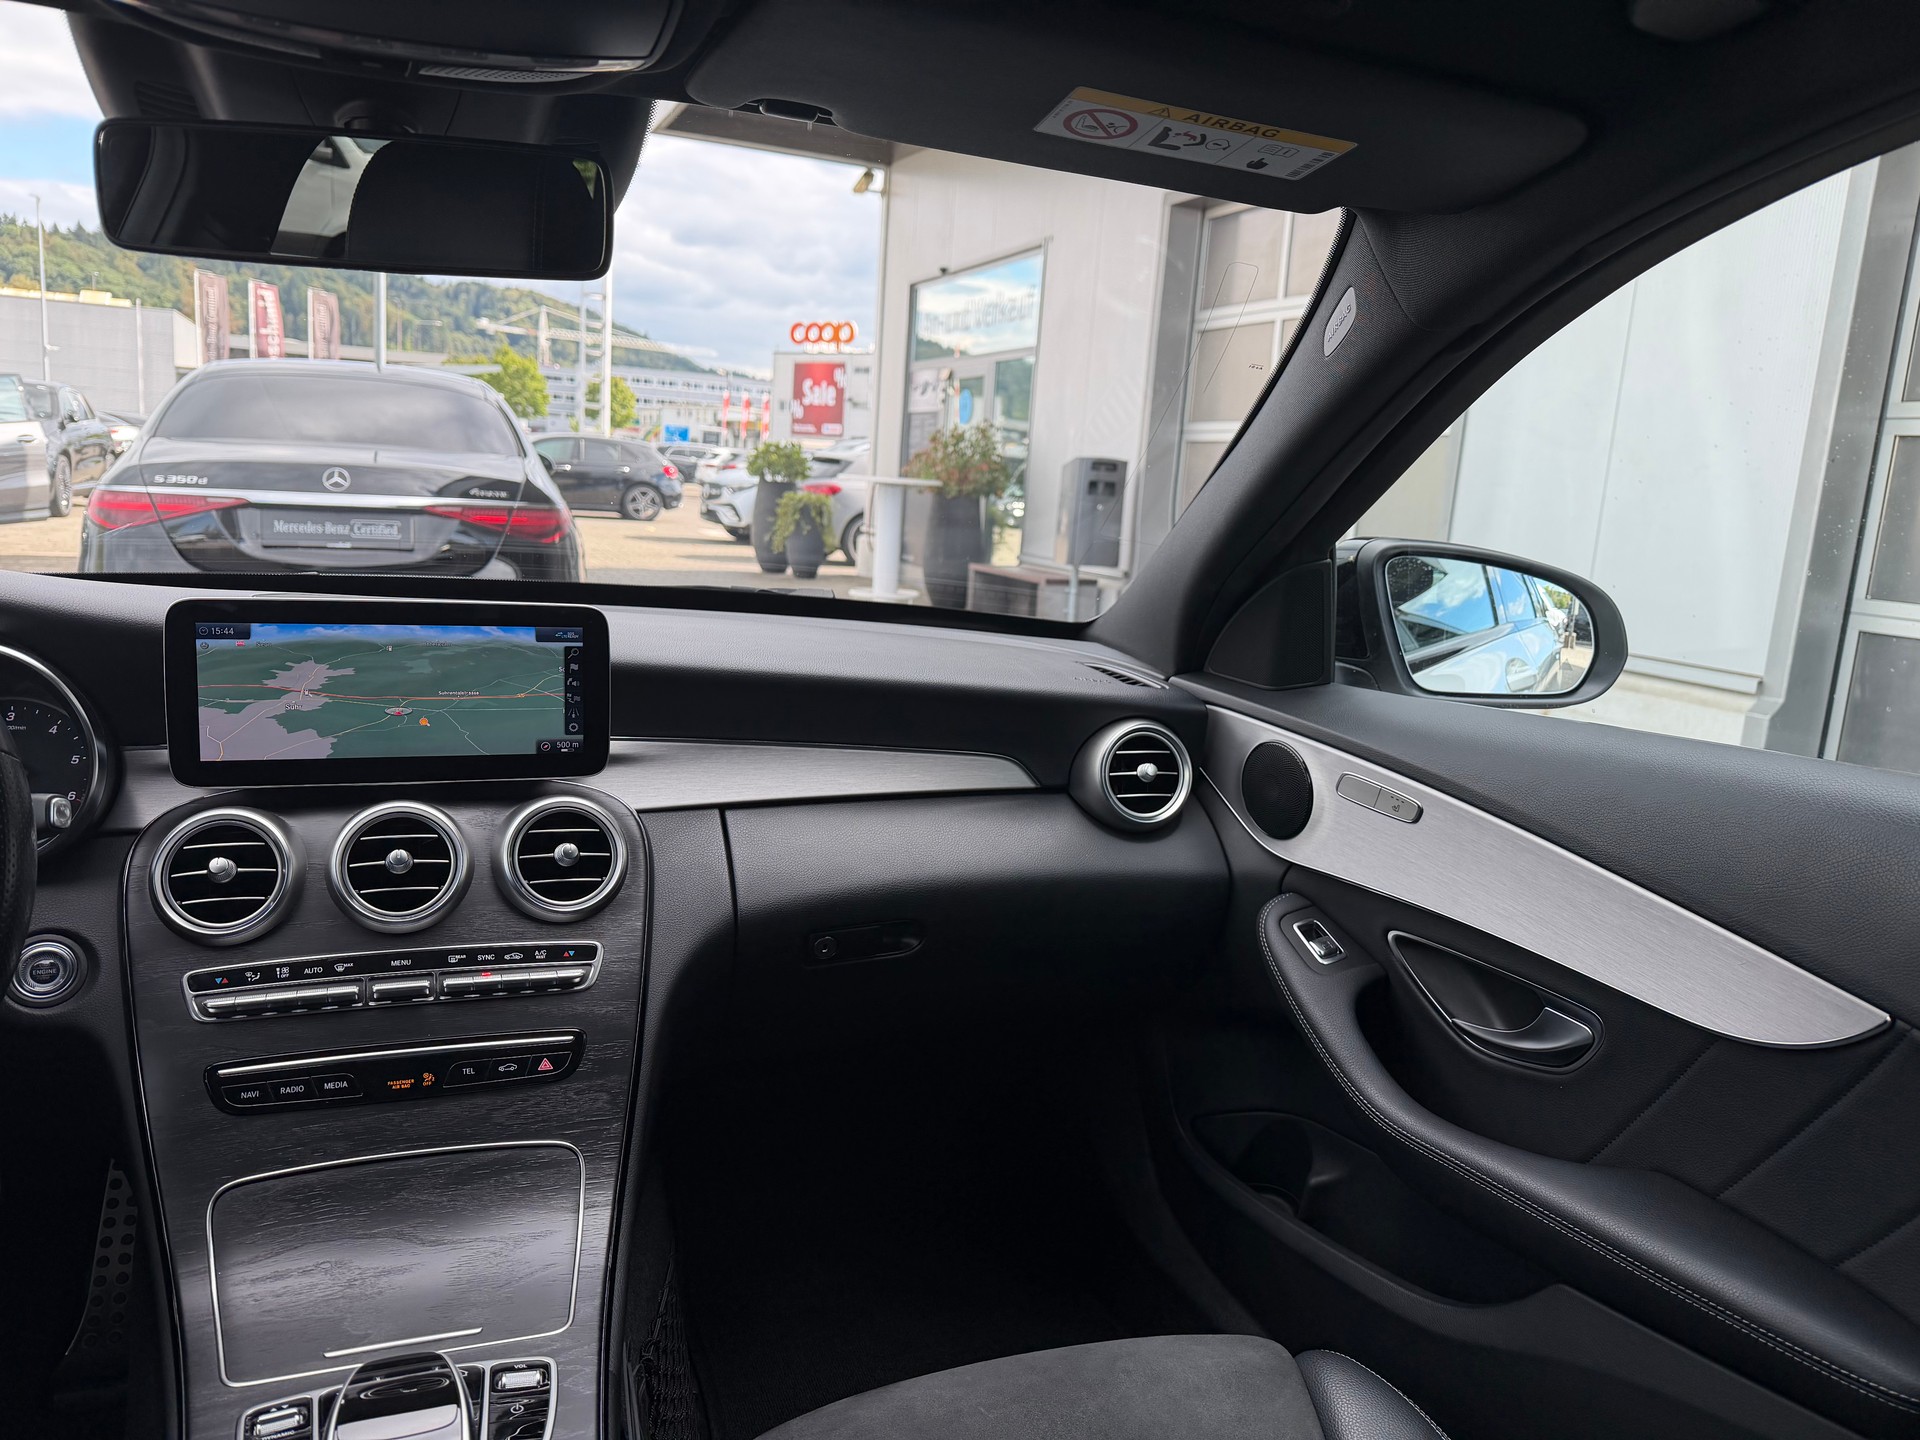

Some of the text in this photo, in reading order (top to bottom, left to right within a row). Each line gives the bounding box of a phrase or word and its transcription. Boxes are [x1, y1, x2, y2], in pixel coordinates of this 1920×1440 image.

[1183, 113, 1281, 139] AIRBAG
[1327, 303, 1352, 343] AIRBAG
[790, 322, 855, 352] coop
[802, 378, 836, 407] Sale
[352, 523, 399, 536] Certified
[211, 627, 234, 635] 15:44
[6, 711, 16, 721] 3
[48, 725, 58, 734] 4
[71, 755, 80, 764] 5
[67, 791, 76, 800] 6
[477, 953, 496, 961] SYNC
[534, 949, 547, 957] A/C
[390, 959, 412, 967] MENU
[32, 968, 57, 976] ENGINE
[303, 966, 324, 975] AUTO
[462, 1067, 476, 1076] TEL
[280, 1084, 305, 1095] RADIO
[323, 1080, 349, 1091] MEDIA
[240, 1090, 260, 1100] NAVI
[261, 1429, 296, 1440] DYNAMIC
